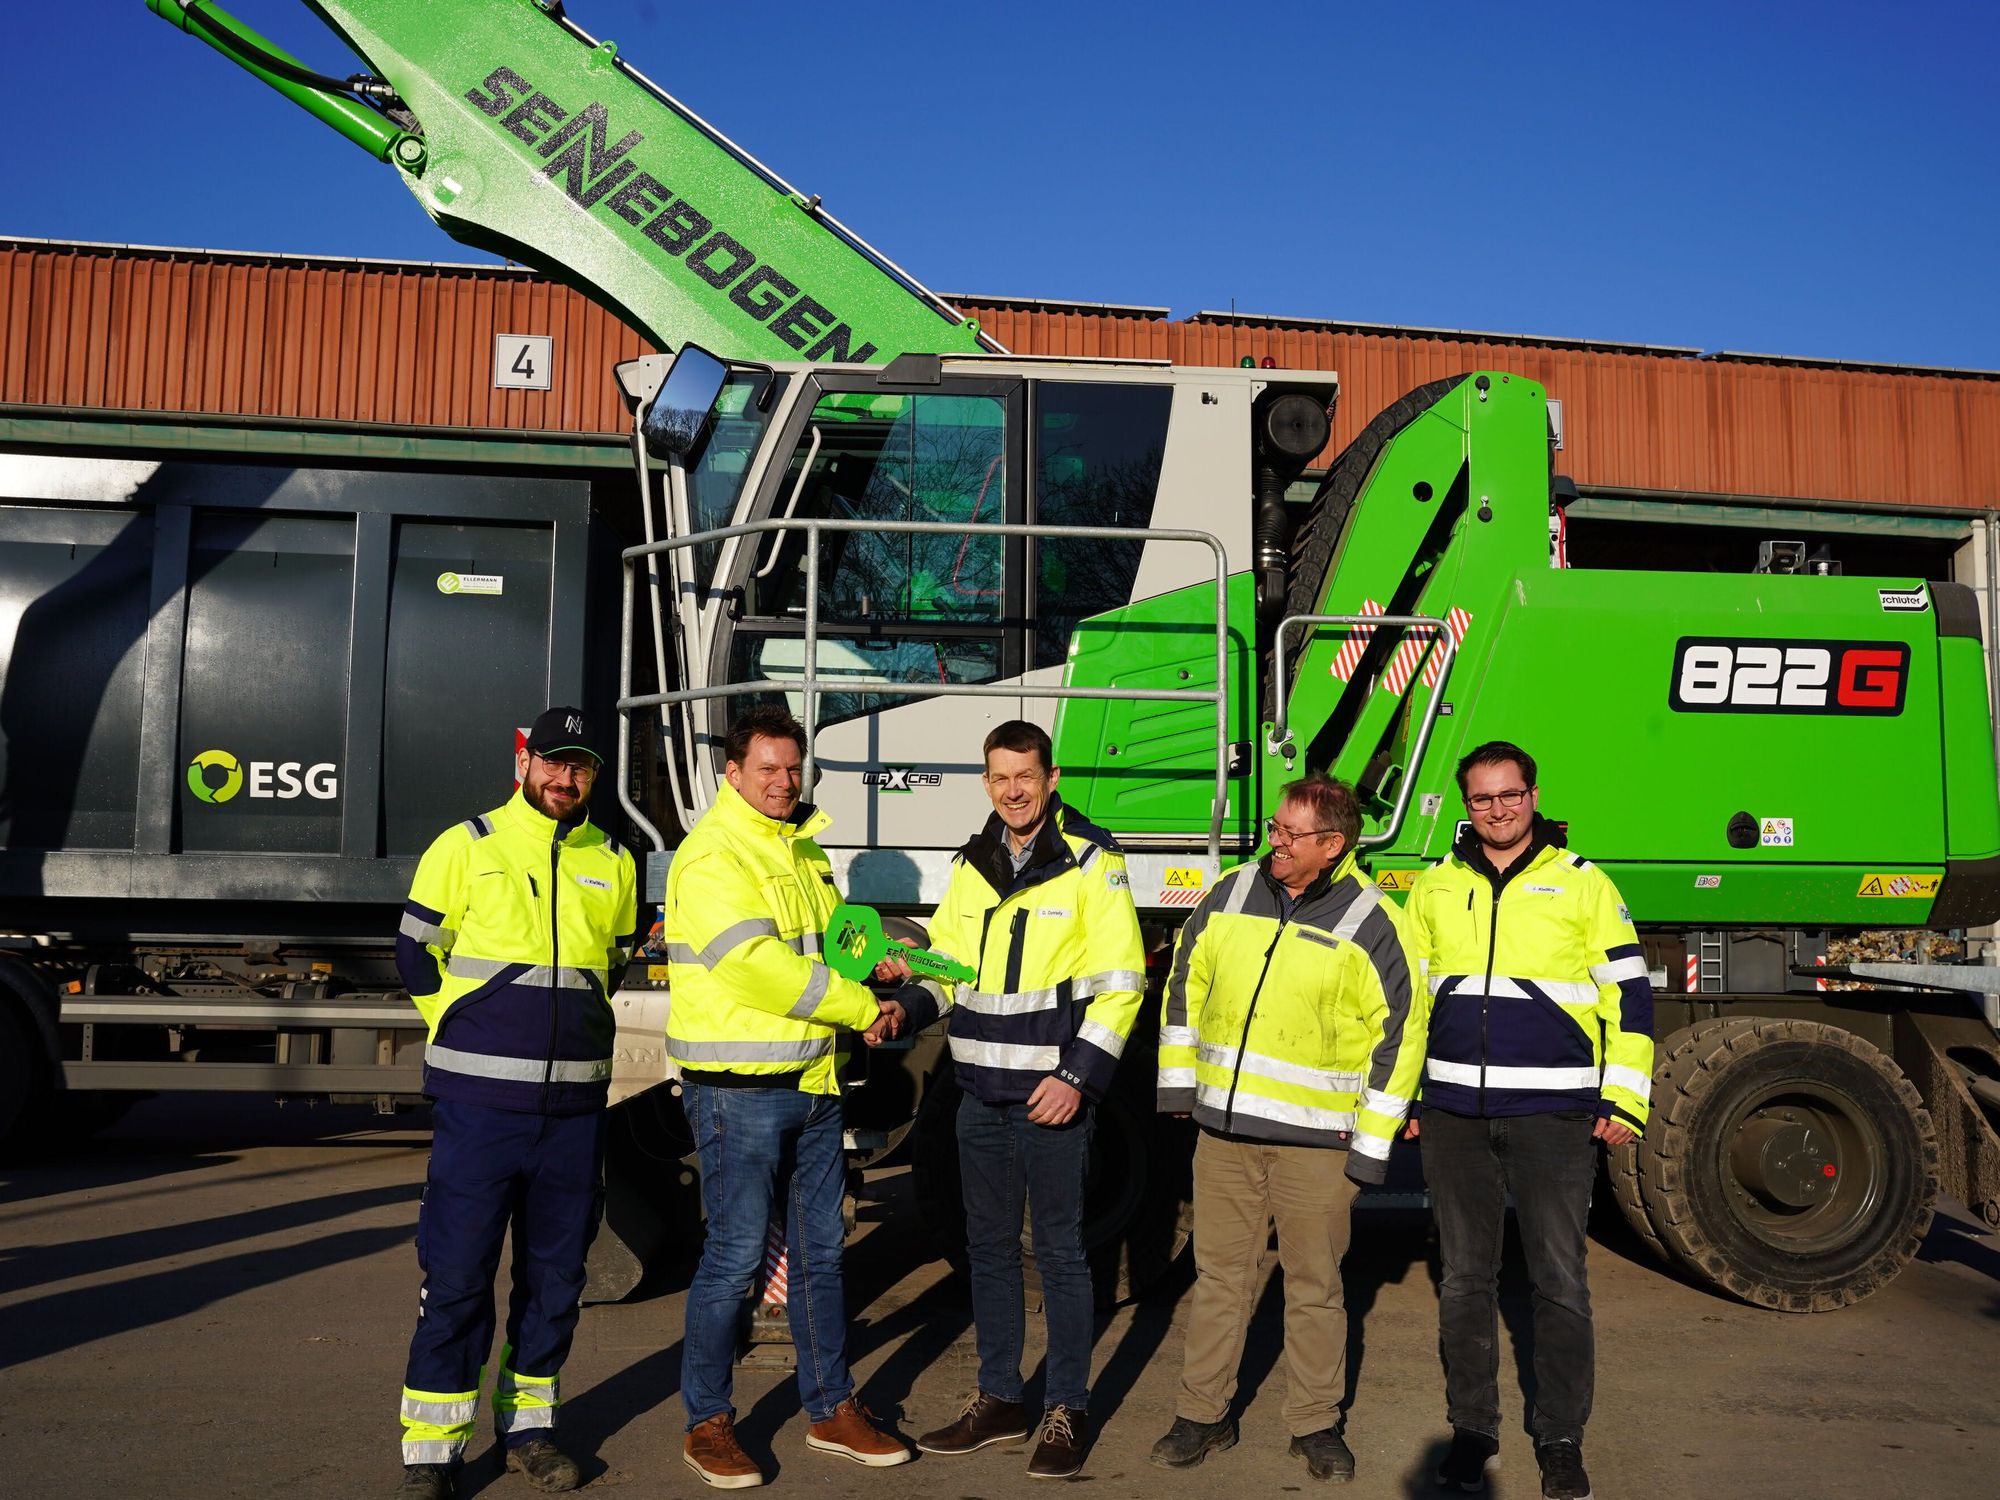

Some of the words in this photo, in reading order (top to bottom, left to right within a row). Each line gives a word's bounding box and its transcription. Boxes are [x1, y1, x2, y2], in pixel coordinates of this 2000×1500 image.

[464, 66, 878, 363] SENNEBOGEN
[511, 344, 535, 379] 4
[249, 761, 338, 800] ESG
[614, 1047, 661, 1063] AN
